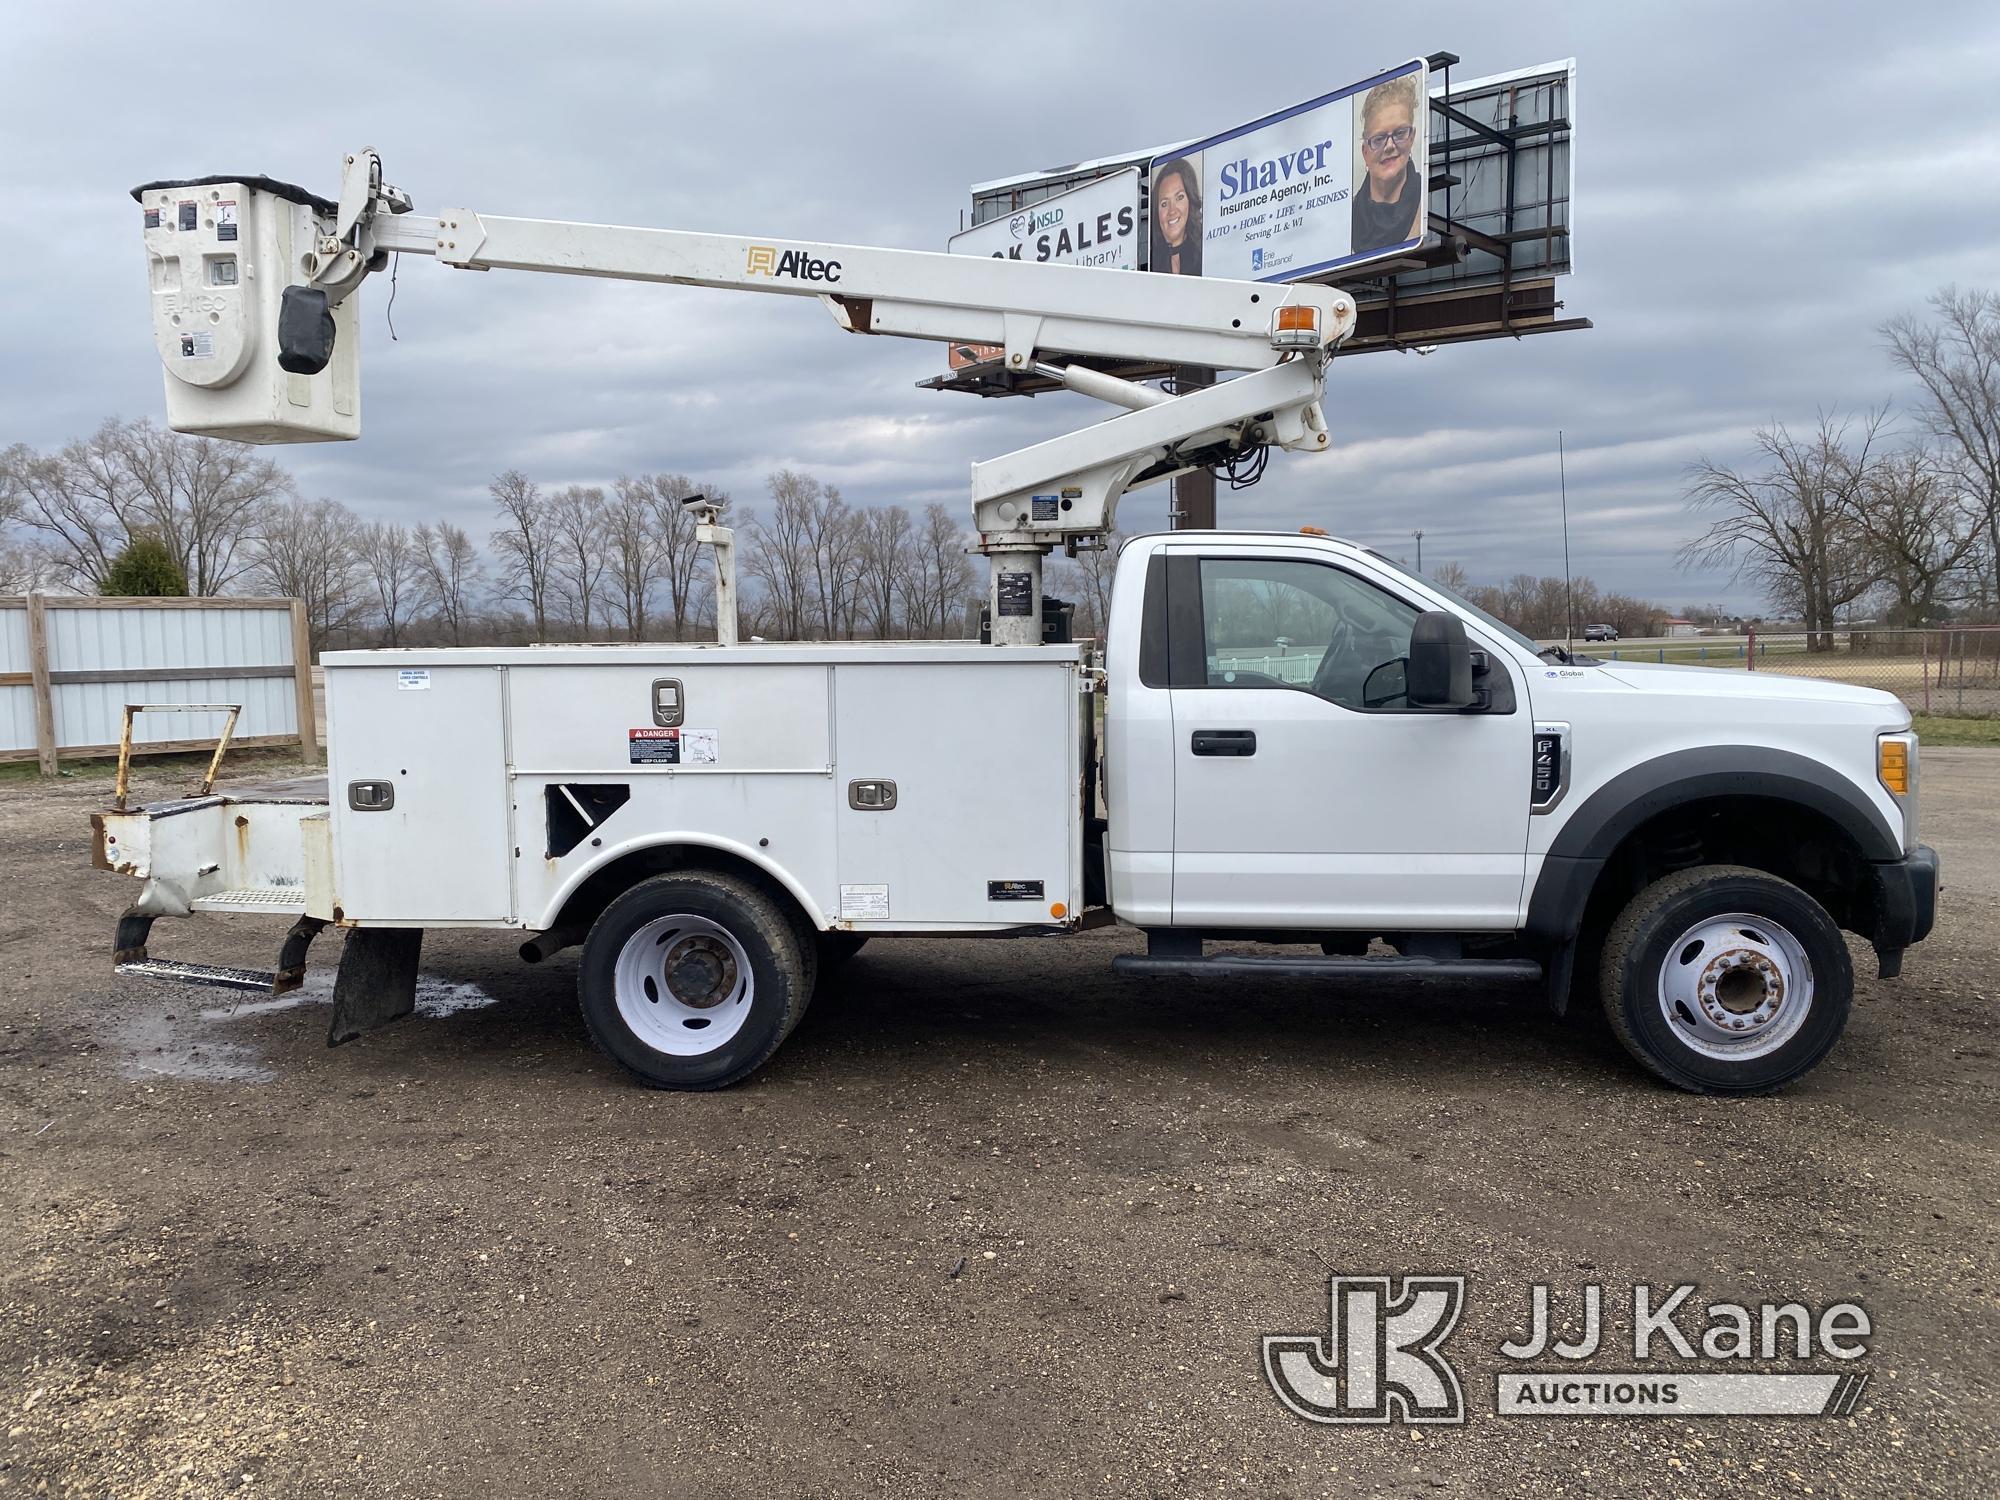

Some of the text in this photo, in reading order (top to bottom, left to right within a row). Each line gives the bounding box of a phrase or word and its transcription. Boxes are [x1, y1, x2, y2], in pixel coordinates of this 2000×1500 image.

[1220, 140, 1333, 201] Shaver
[1206, 188, 1349, 240] AUTO HOME LIFE BUSINESS
[1220, 174, 1333, 217] Insurance Agency, Inc.
[1036, 208, 1064, 230] NSLD
[1036, 205, 1133, 262] SALES
[1244, 228, 1272, 242] Serving
[775, 250, 842, 282] Altec
[1012, 882, 1026, 890] Altec
